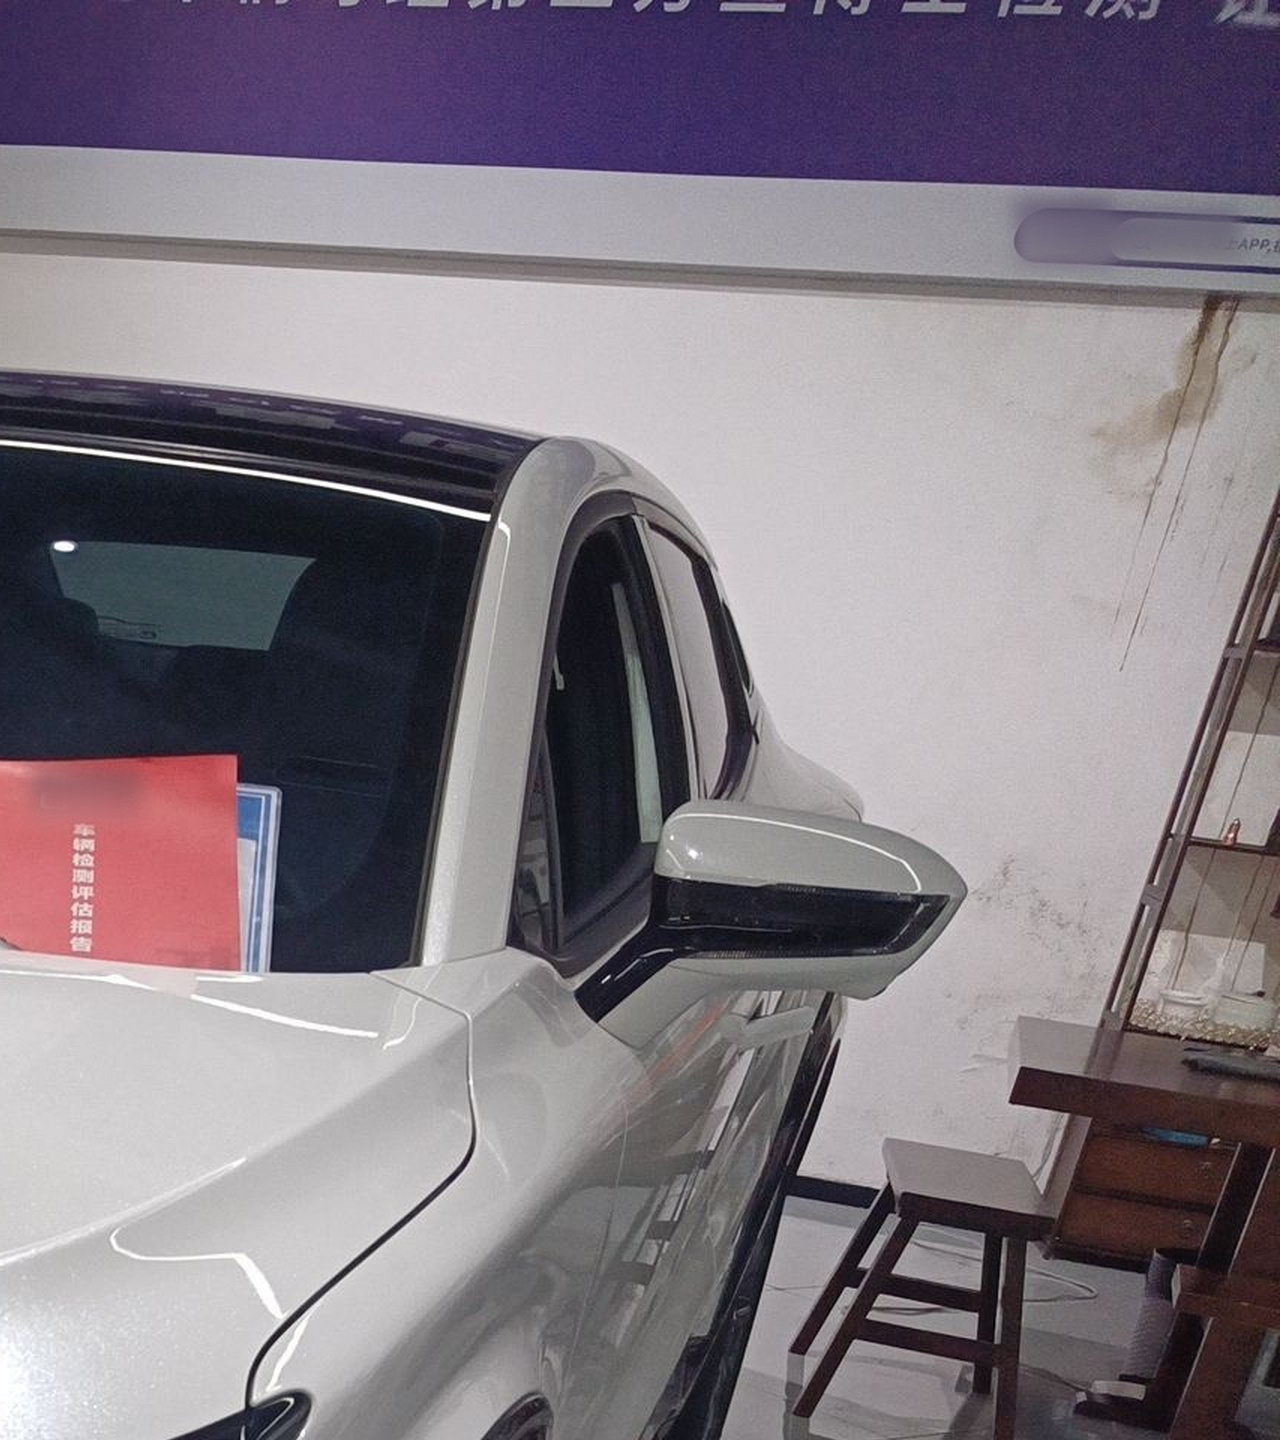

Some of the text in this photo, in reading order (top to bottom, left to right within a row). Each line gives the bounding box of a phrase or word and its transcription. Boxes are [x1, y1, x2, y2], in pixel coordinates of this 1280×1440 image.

[69, 823, 96, 953] 车辆检测评估报告
